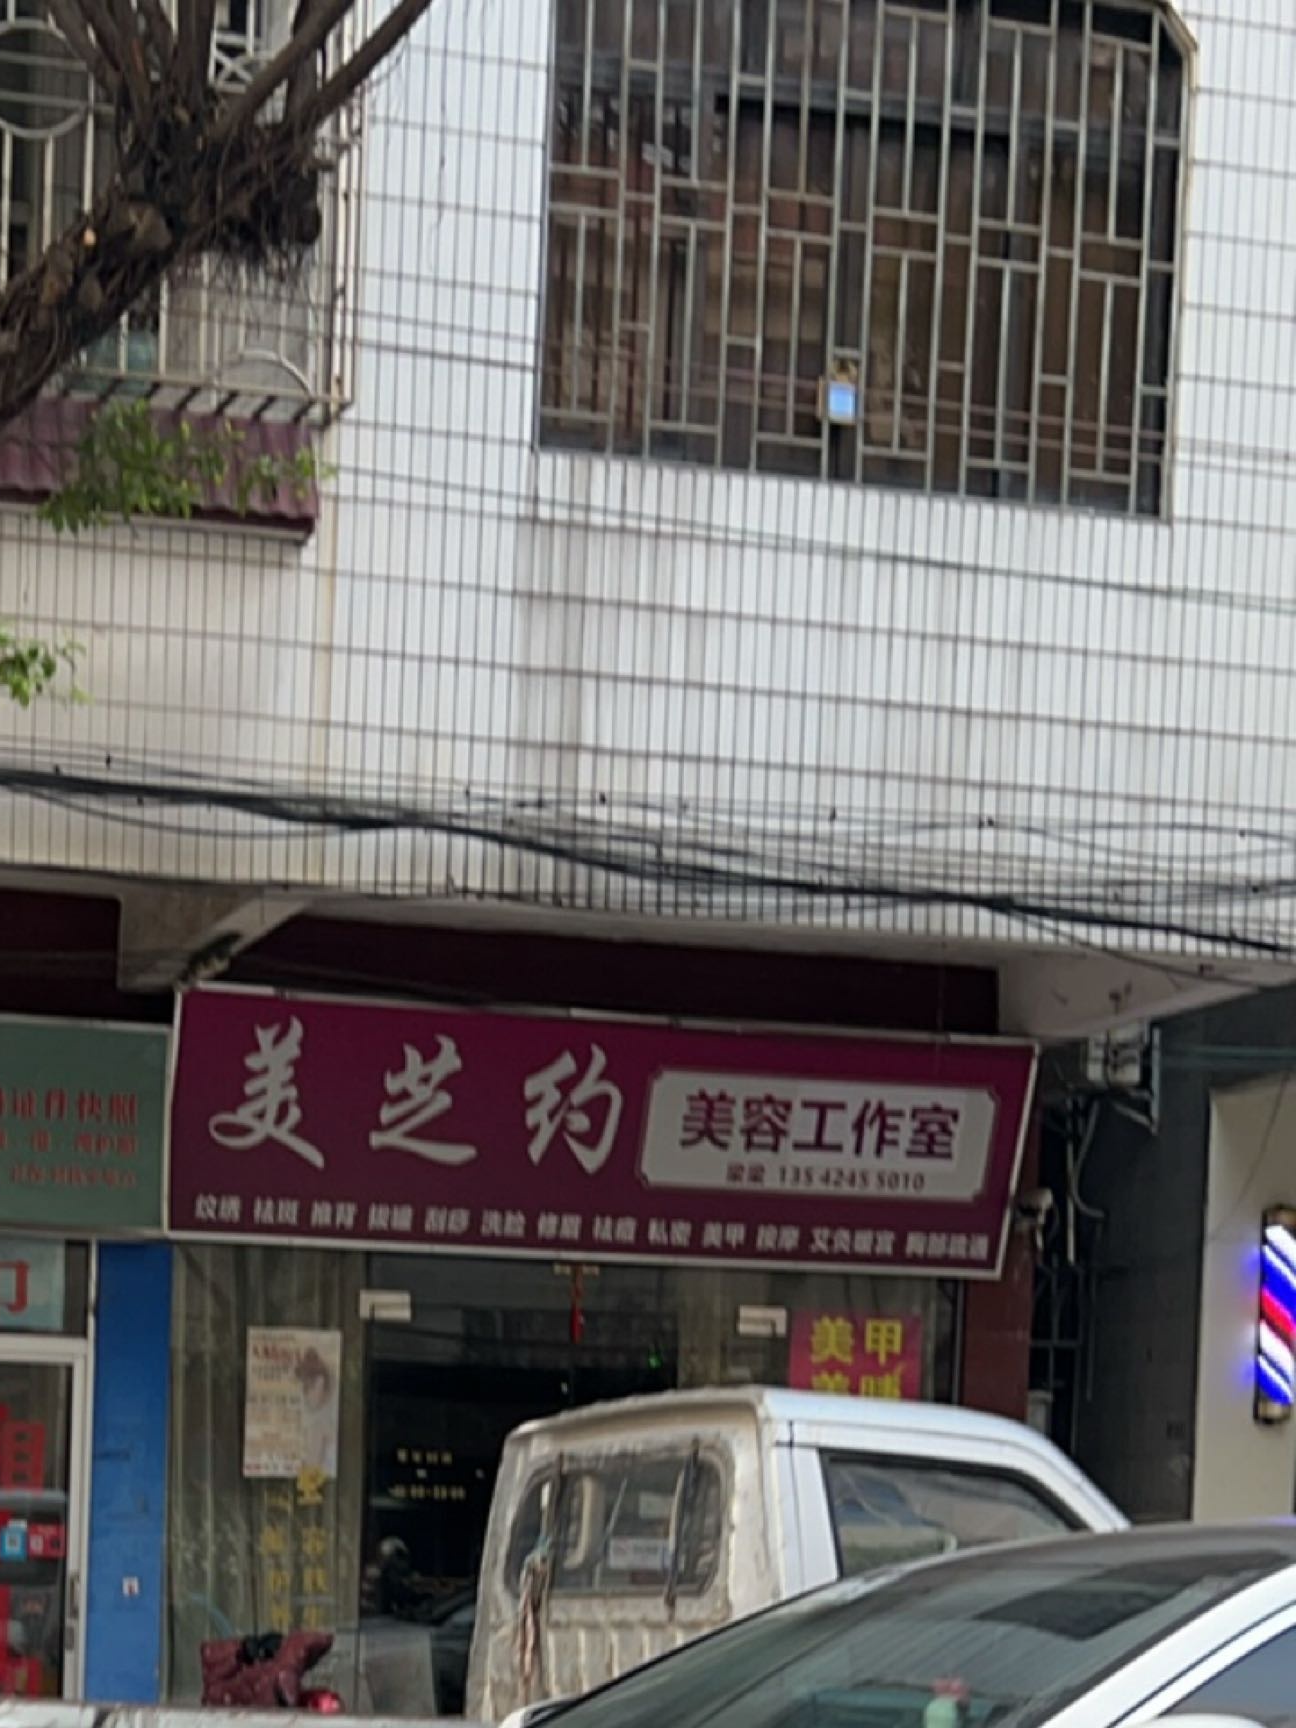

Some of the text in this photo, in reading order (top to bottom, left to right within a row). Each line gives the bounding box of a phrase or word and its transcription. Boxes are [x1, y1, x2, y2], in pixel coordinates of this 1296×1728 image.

[209, 1016, 623, 1175] 美芝约
[680, 1089, 960, 1160] 美容工作室
[809, 1314, 904, 1367] 美甲
